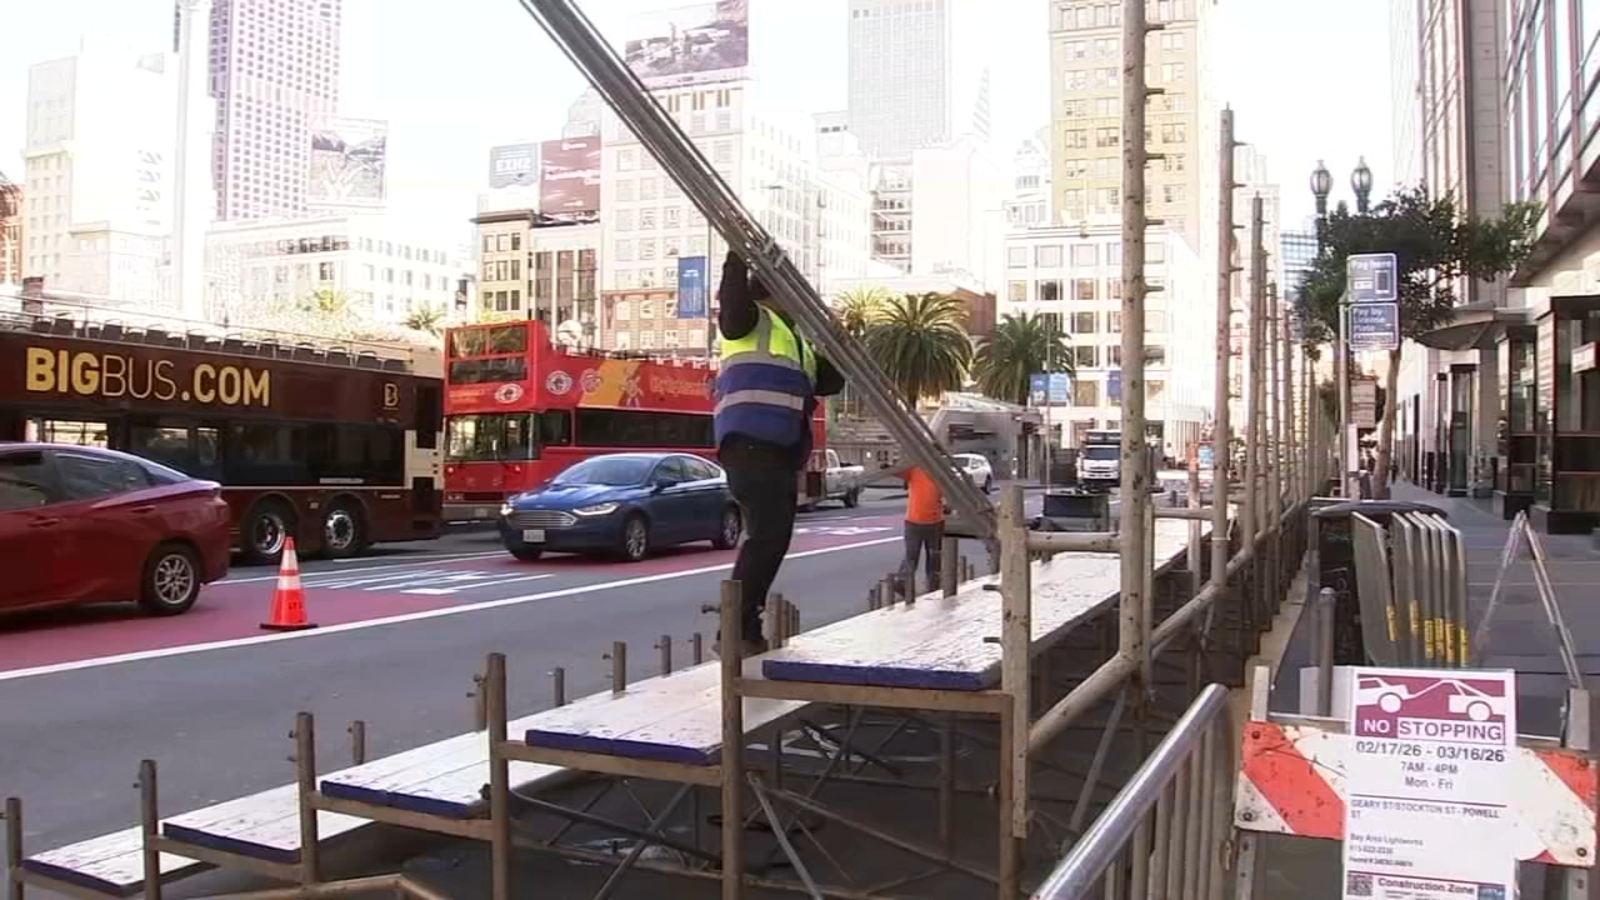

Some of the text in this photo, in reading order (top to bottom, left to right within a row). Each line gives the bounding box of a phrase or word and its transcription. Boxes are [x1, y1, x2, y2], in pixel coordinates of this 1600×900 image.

[26, 347, 270, 407] BIGBUS.COM
[1363, 719, 1502, 741] NO STOPPING
[1356, 740, 1422, 757] 02/17/26
[1437, 745, 1505, 763] 03/16/26
[1401, 761, 1425, 772] 7AM
[1434, 763, 1459, 774] 4PM
[1405, 776, 1428, 788] Mon
[1438, 778, 1454, 790] Fri
[1351, 799, 1380, 809] GEARY
[1445, 804, 1456, 814] ST
[1463, 807, 1501, 818] POWELL
[1351, 810, 1361, 819] ST
[1350, 833, 1364, 842] Bay
[1378, 877, 1446, 891] Construction
[1448, 883, 1475, 894] Zone
